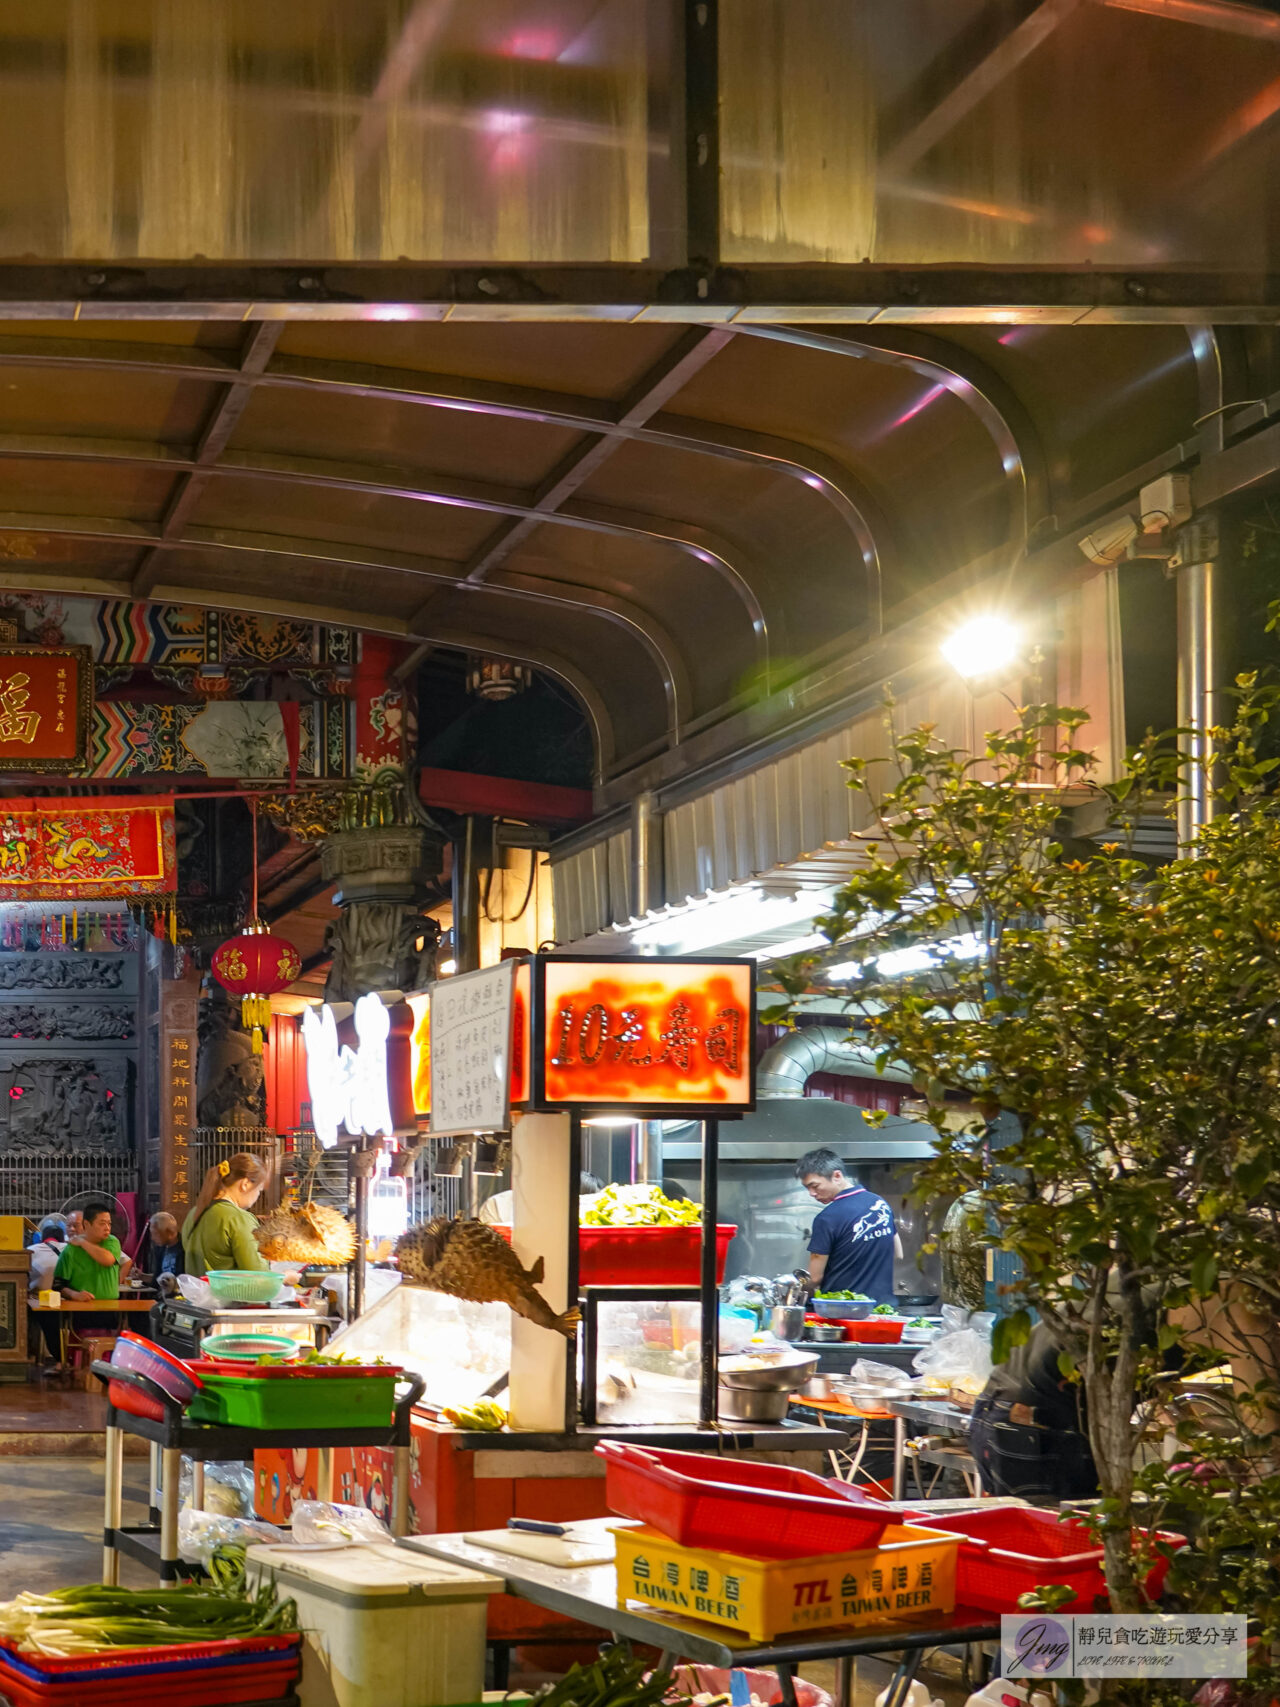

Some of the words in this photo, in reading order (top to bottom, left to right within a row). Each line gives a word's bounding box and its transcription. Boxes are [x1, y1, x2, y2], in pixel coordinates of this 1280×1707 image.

[633, 1580, 689, 1608] TAIWAN
[695, 1596, 739, 1621] BEER
[793, 1579, 832, 1606] TTL
[841, 1598, 890, 1617] TAIWAN
[896, 1589, 930, 1609] BEER
